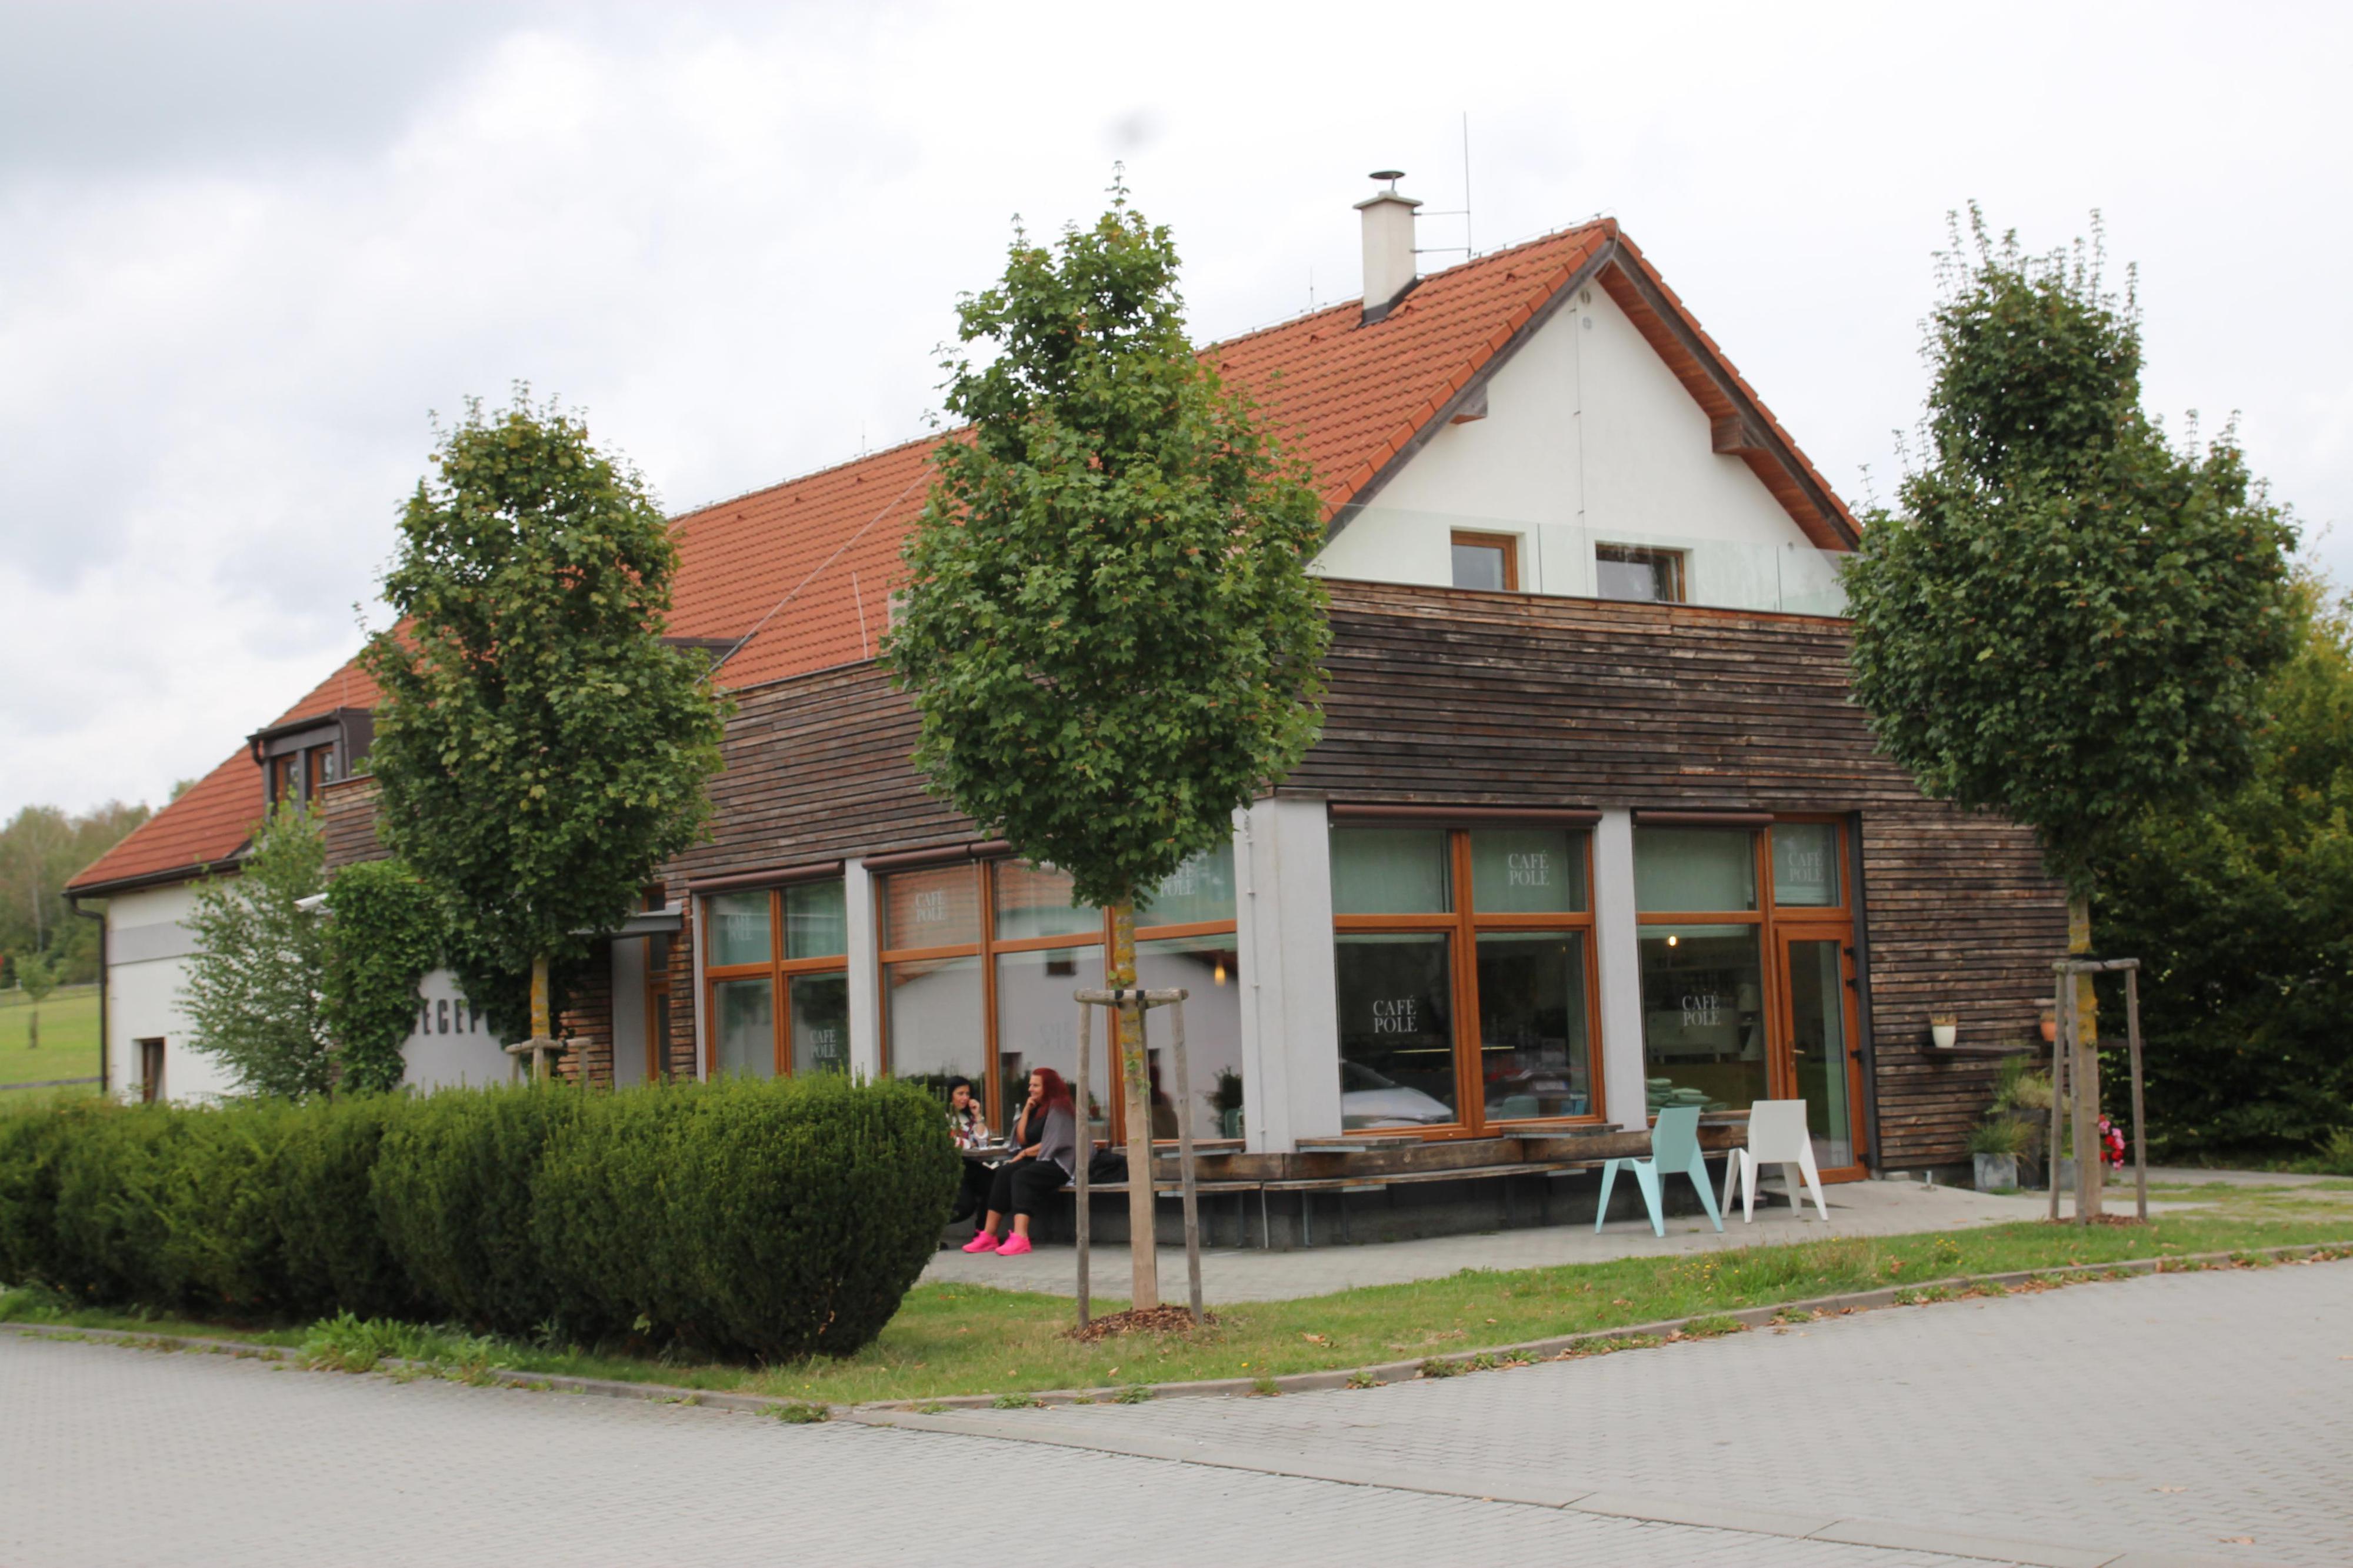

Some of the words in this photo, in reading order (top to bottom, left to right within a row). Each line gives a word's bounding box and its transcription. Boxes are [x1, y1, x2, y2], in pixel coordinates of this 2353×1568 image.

[1508, 850, 1549, 870] CAFÉ
[1509, 869, 1550, 886] POLE
[1789, 867, 1824, 882] POLE
[1159, 879, 1195, 898] POLE
[1373, 995, 1417, 1016] CAFÉ
[1374, 1015, 1418, 1034] POLE
[1683, 1010, 1721, 1027] POLE
